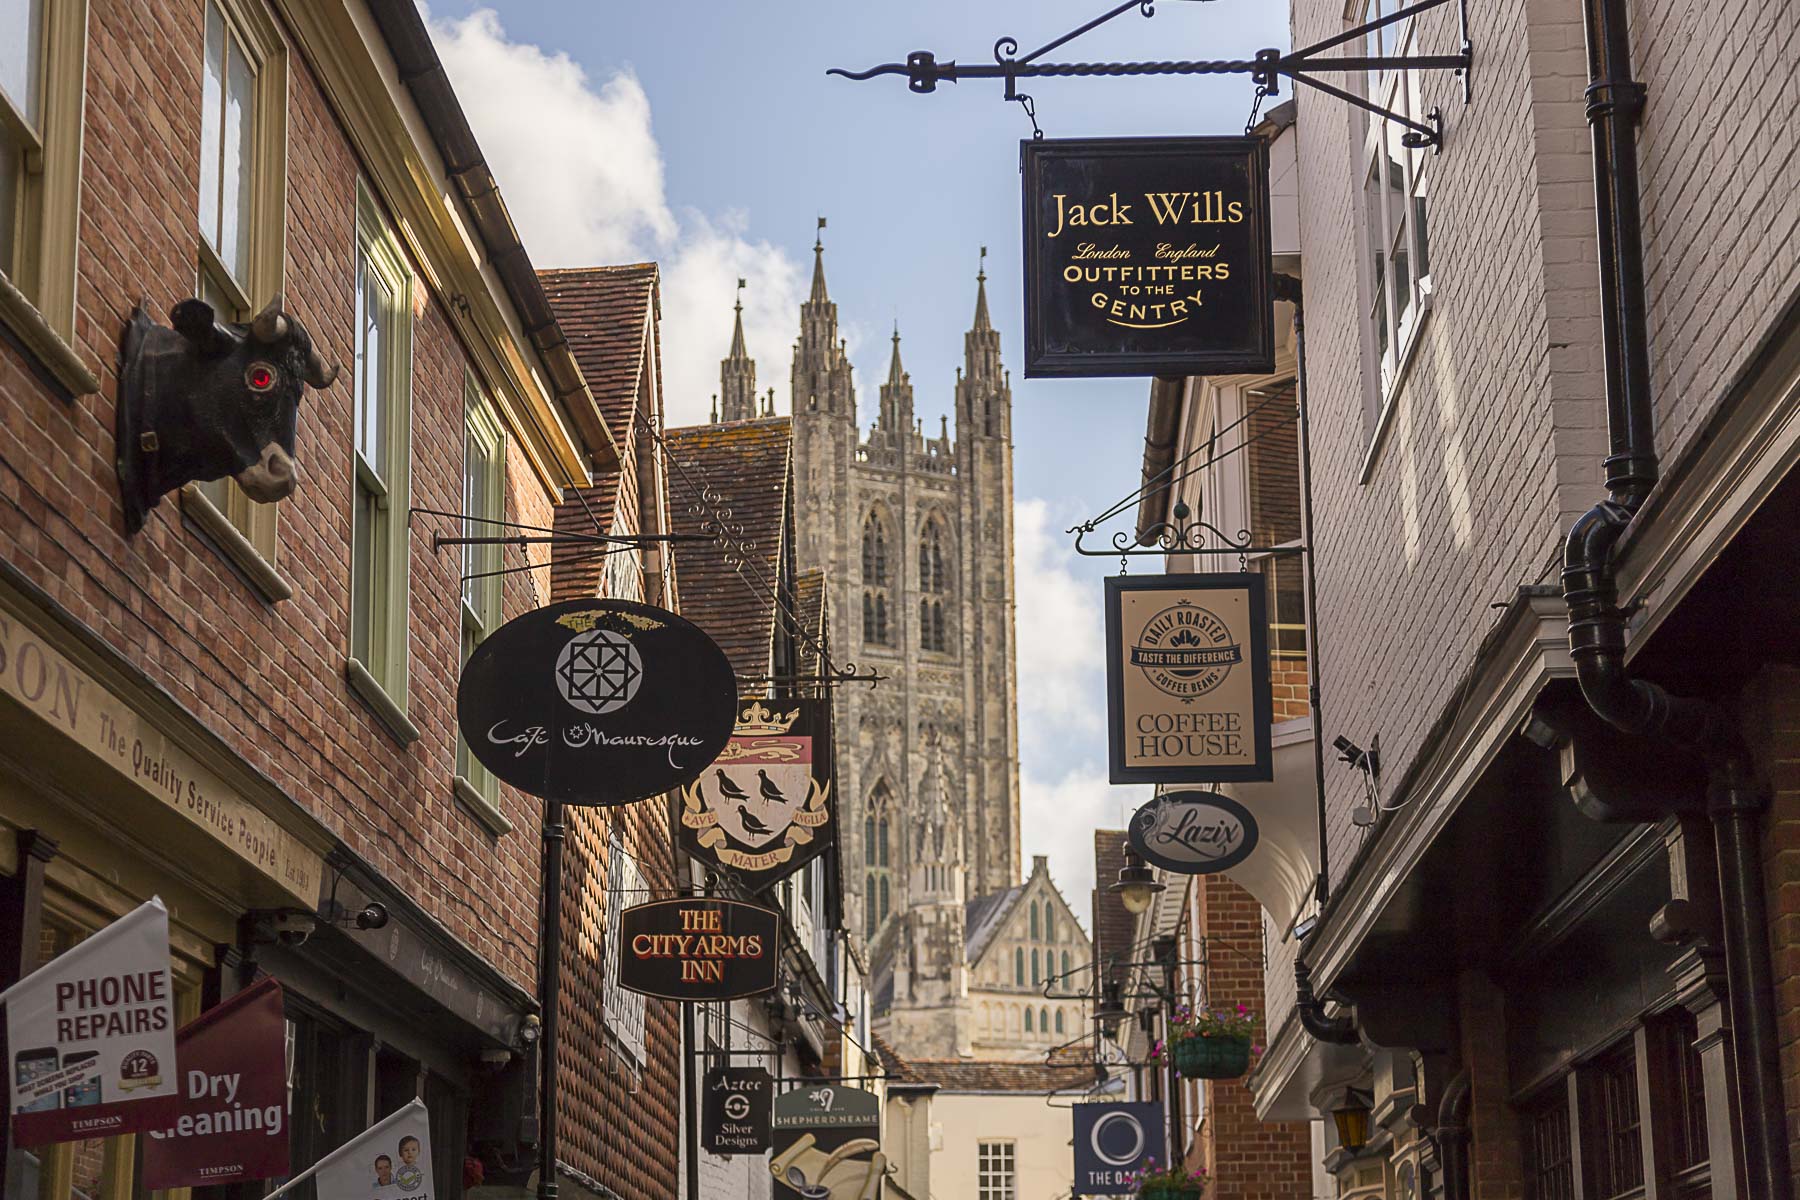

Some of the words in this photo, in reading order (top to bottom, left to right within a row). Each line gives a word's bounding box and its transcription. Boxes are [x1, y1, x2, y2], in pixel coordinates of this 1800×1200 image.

[1048, 192, 1134, 237] Jack
[1144, 191, 1243, 225] Wills
[1071, 242, 1131, 260] London
[1154, 243, 1220, 263] England
[1063, 263, 1230, 283] OUTFITTERS
[1120, 285, 1140, 296] TO
[1145, 284, 1175, 295] THE
[1091, 290, 1203, 320] GENTRY
[1144, 614, 1174, 645] DAILY
[1177, 611, 1226, 643] ROASTED
[1138, 652, 1164, 663] TASTE
[1166, 653, 1182, 664] THE
[1183, 650, 1236, 664] DIFFERENCE
[1156, 672, 1188, 693] COFFEE
[1191, 671, 1219, 693] BEANS
[1137, 712, 1241, 734] COFFEE
[487, 719, 550, 758] Café
[1136, 734, 1242, 757] HOUSE
[99, 711, 126, 758] The
[132, 739, 183, 805] Quality
[187, 780, 234, 837] Service
[239, 817, 276, 867] People
[1157, 808, 1238, 859] Lazix
[731, 852, 780, 869] MATER
[679, 909, 723, 933] THE
[632, 933, 695, 960] CITY
[692, 934, 763, 960] ARMS
[680, 960, 724, 983] INN
[56, 970, 166, 1012] PHONE
[57, 1006, 167, 1042] REPAIRS
[131, 1058, 149, 1073] 12
[188, 1070, 241, 1104] Dry
[712, 1075, 762, 1091] Aztec
[71, 1115, 122, 1129] TIMPSON
[721, 1123, 753, 1135] Silver
[776, 1115, 837, 1126] SHEPHERD
[839, 1114, 878, 1124] NEAME
[715, 1135, 758, 1149] Designs
[199, 1164, 244, 1175] TIMPSON
[1088, 1171, 1112, 1186] THE
